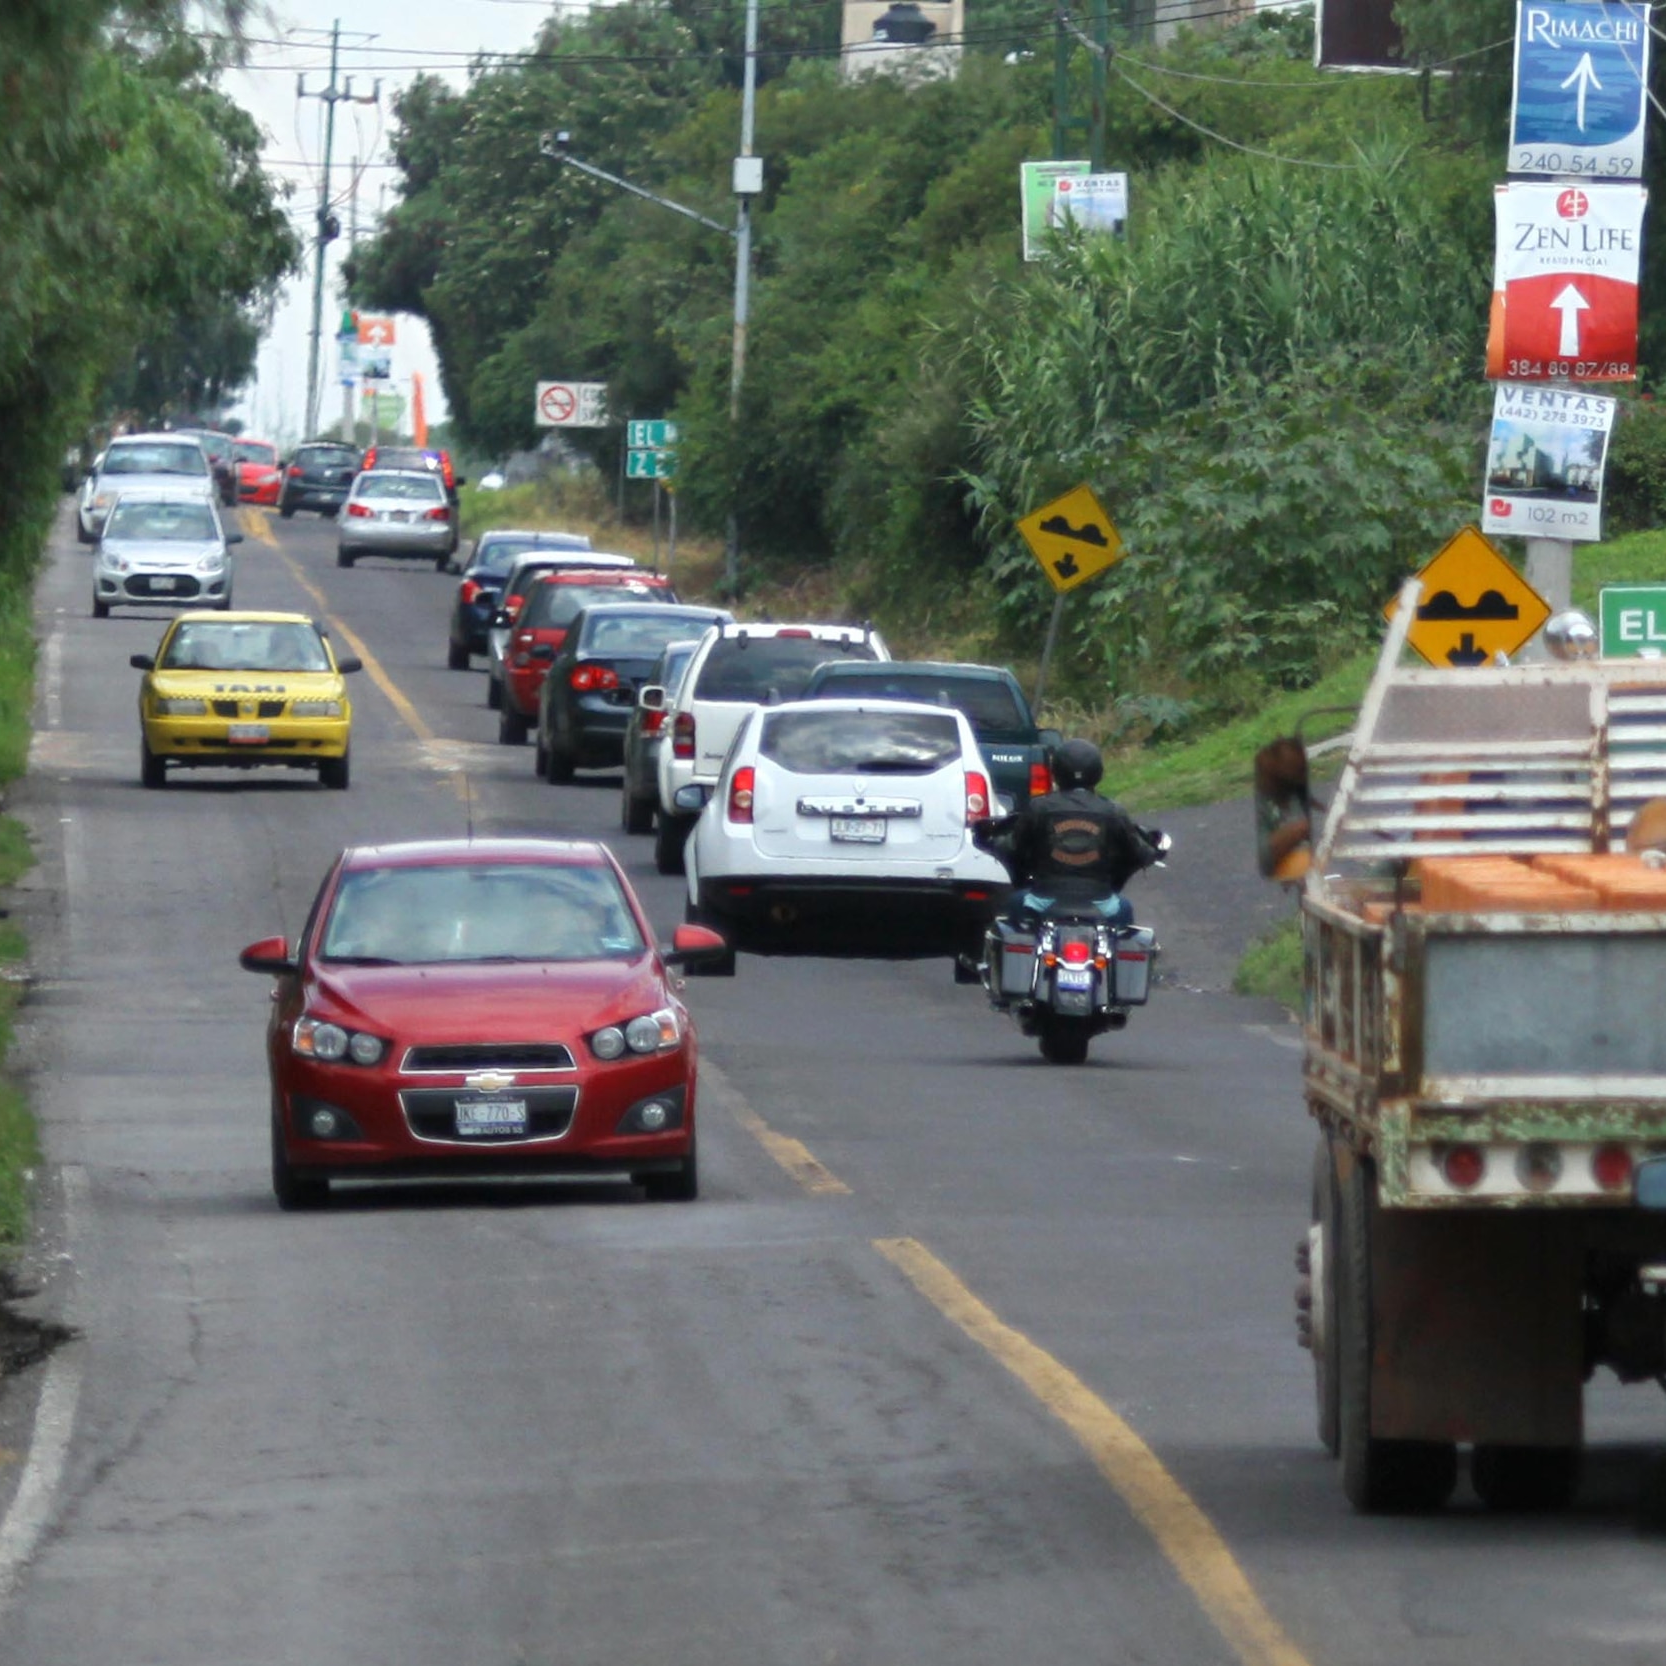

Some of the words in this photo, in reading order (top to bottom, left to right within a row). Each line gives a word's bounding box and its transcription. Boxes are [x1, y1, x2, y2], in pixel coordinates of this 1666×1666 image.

[1527, 10, 1638, 48] RIMACHI
[1519, 152, 1634, 176] 240.54.59
[1514, 223, 1570, 251] ZEN
[1581, 224, 1633, 252] LIFE
[1507, 360, 1542, 376] 384
[1548, 361, 1570, 375] 80
[1502, 387, 1608, 414] VENTAS
[1499, 406, 1538, 420] (442)
[1542, 410, 1567, 423] 278
[1528, 507, 1556, 524] 102
[1561, 512, 1589, 526] m2
